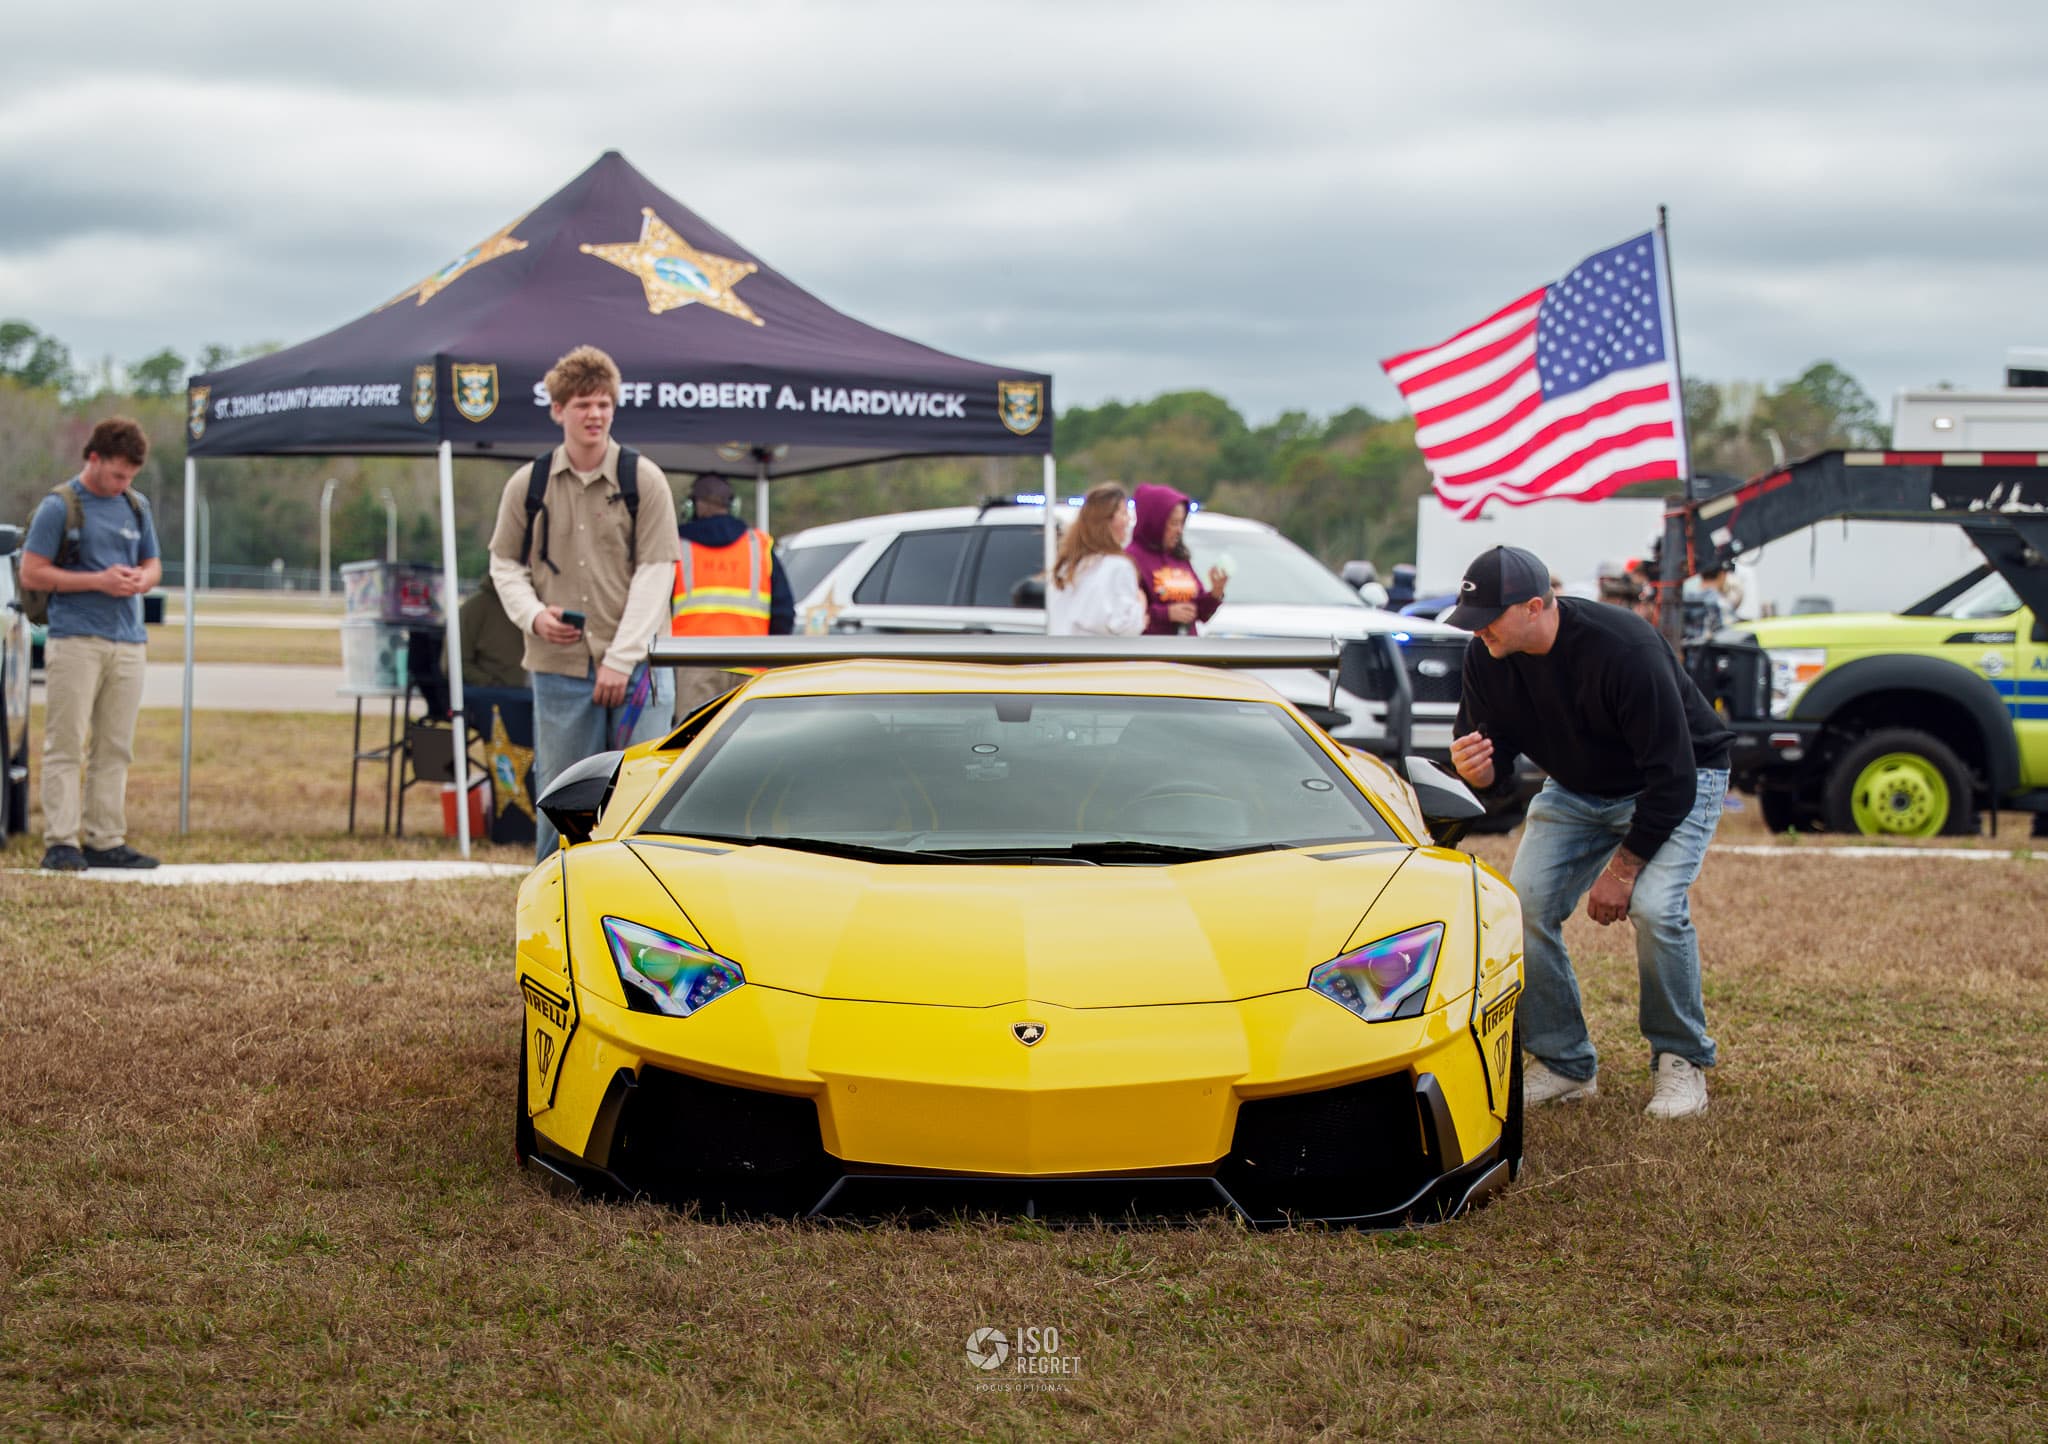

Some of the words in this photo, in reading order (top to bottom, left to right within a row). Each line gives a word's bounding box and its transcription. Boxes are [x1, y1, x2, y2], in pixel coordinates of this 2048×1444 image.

[231, 392, 266, 418] JOHNS
[266, 386, 307, 413] COUNTY
[360, 383, 402, 407] OFFICE
[658, 382, 772, 408] ROBERT
[775, 385, 806, 411] A.
[810, 386, 967, 418] HARDWICK
[519, 972, 570, 1031] PIRELLI
